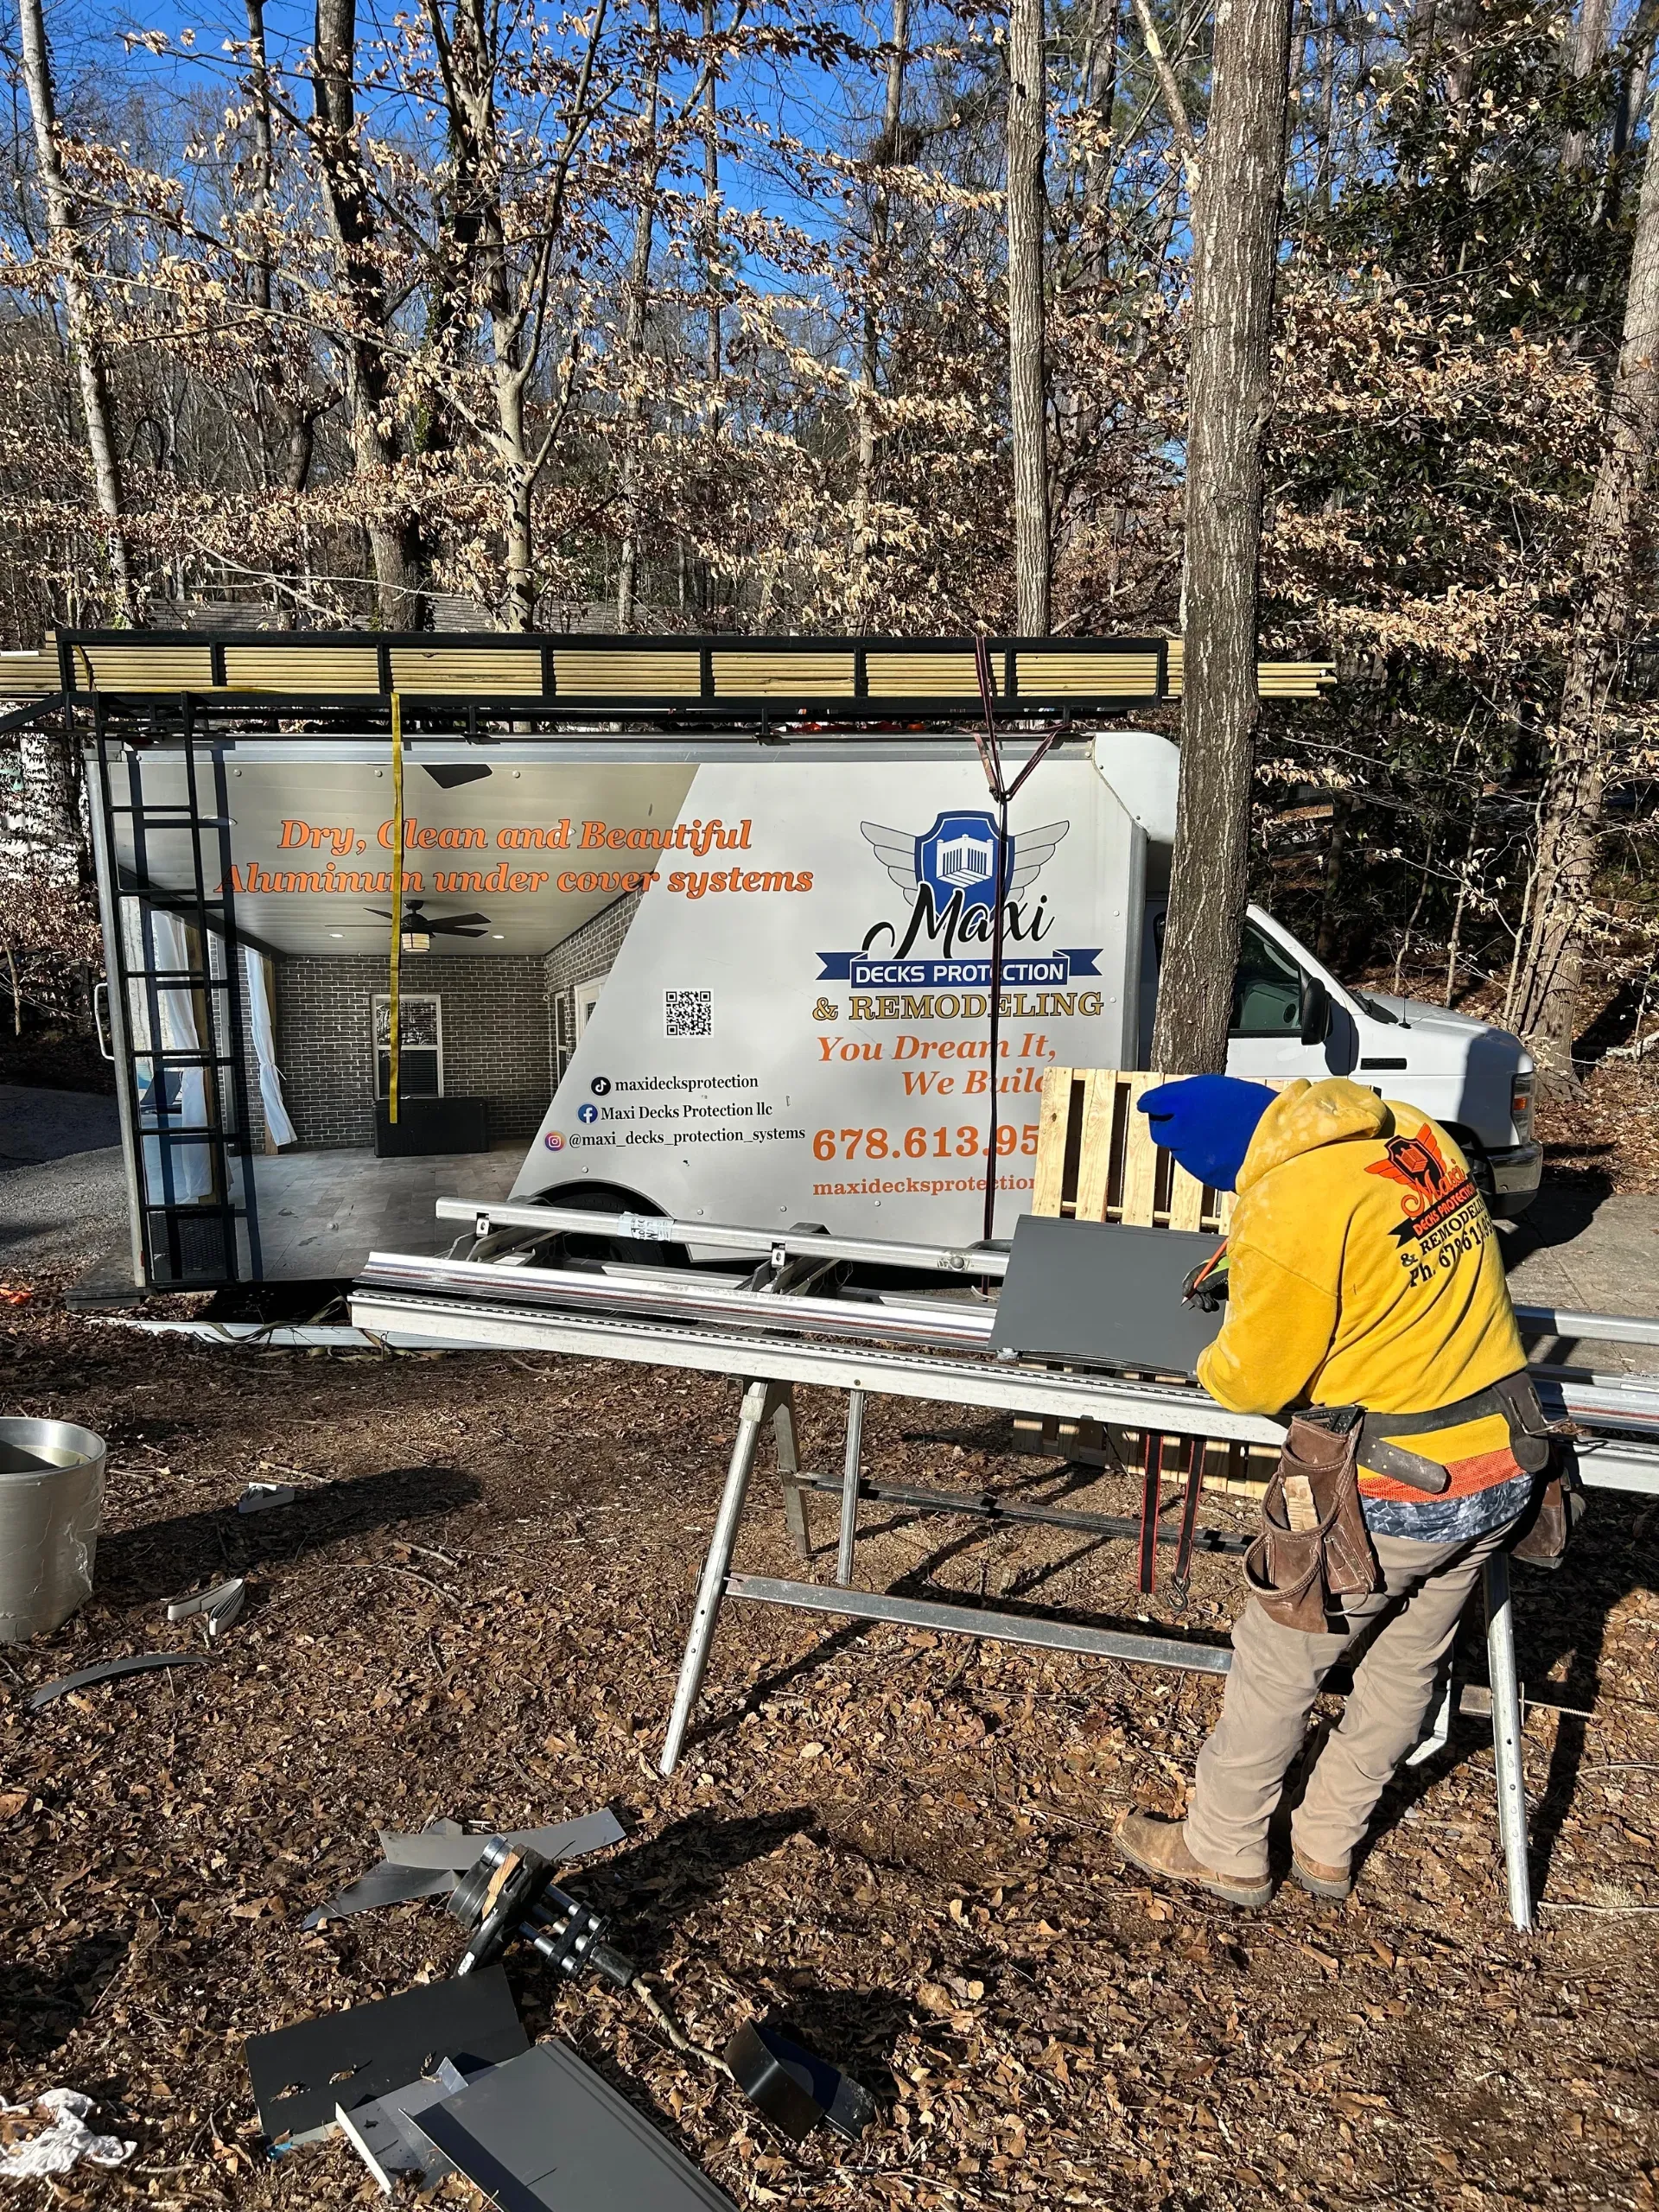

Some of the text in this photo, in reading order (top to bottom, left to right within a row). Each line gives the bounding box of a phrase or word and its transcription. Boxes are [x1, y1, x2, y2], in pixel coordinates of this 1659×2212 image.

[277, 818, 752, 856] Dry, Clean and Beautiful
[213, 862, 813, 899] Aluminum under cover systems
[861, 883, 1055, 959] Maxi
[855, 963, 1064, 983] DECKS PROTCTION
[812, 991, 1104, 1020] & REMODELING
[817, 1033, 1057, 1062] You Dream It,
[615, 1074, 759, 1093] maxidecksprotection
[901, 1071, 955, 1096] We
[601, 1102, 772, 1120] Maxi Decks Protection llc
[569, 1127, 805, 1148] @maxi_decks_protection_systems
[1401, 1159, 1466, 1217] Maxi
[1413, 1212, 1439, 1236] DECKS
[1401, 1253, 1419, 1268] &
[1409, 1263, 1436, 1287] Ph.
